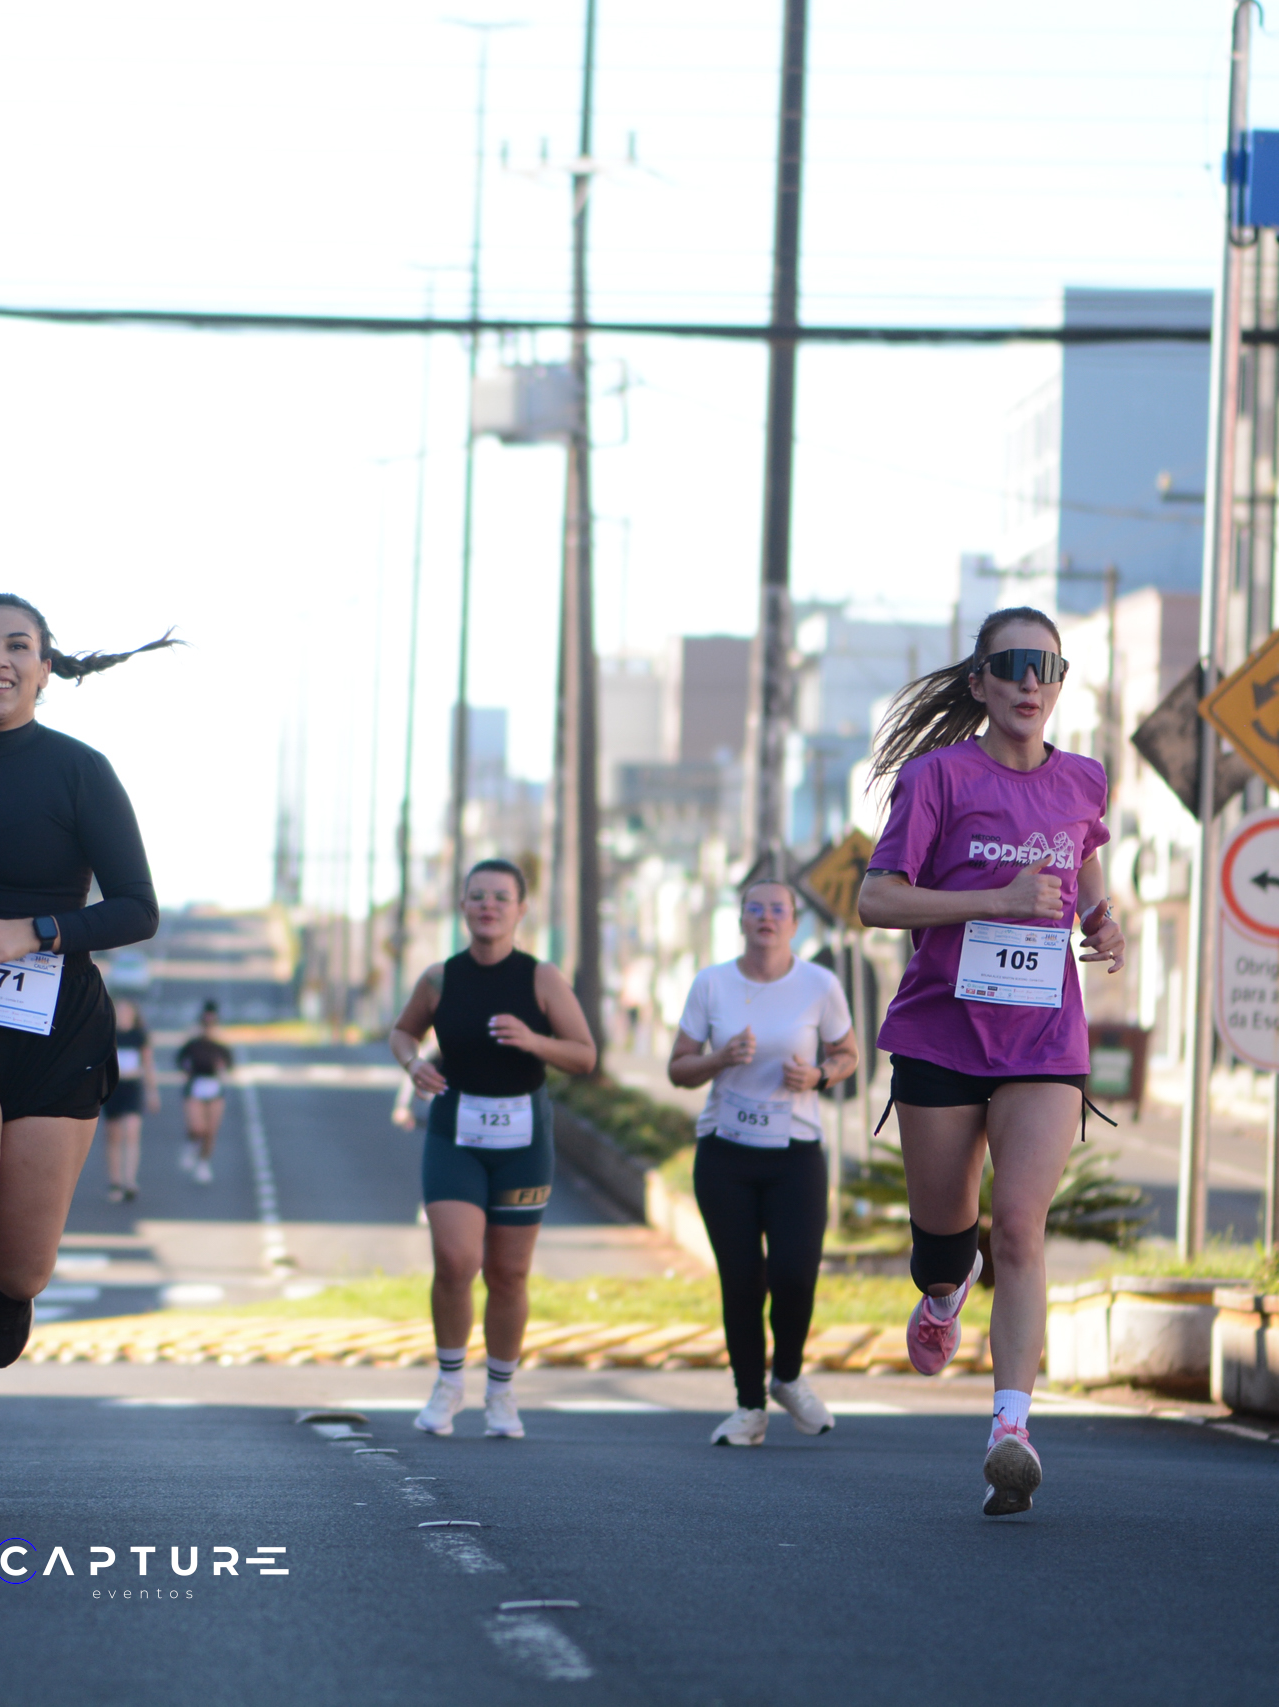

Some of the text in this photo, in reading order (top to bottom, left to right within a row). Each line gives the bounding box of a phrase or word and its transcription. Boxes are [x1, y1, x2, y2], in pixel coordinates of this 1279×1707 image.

[968, 841, 1074, 870] PODEROSA
[996, 949, 1039, 971] 105
[1231, 988, 1267, 1004] para
[1228, 1011, 1247, 1028] da
[480, 1113, 511, 1127] 123
[737, 1110, 769, 1127] 053
